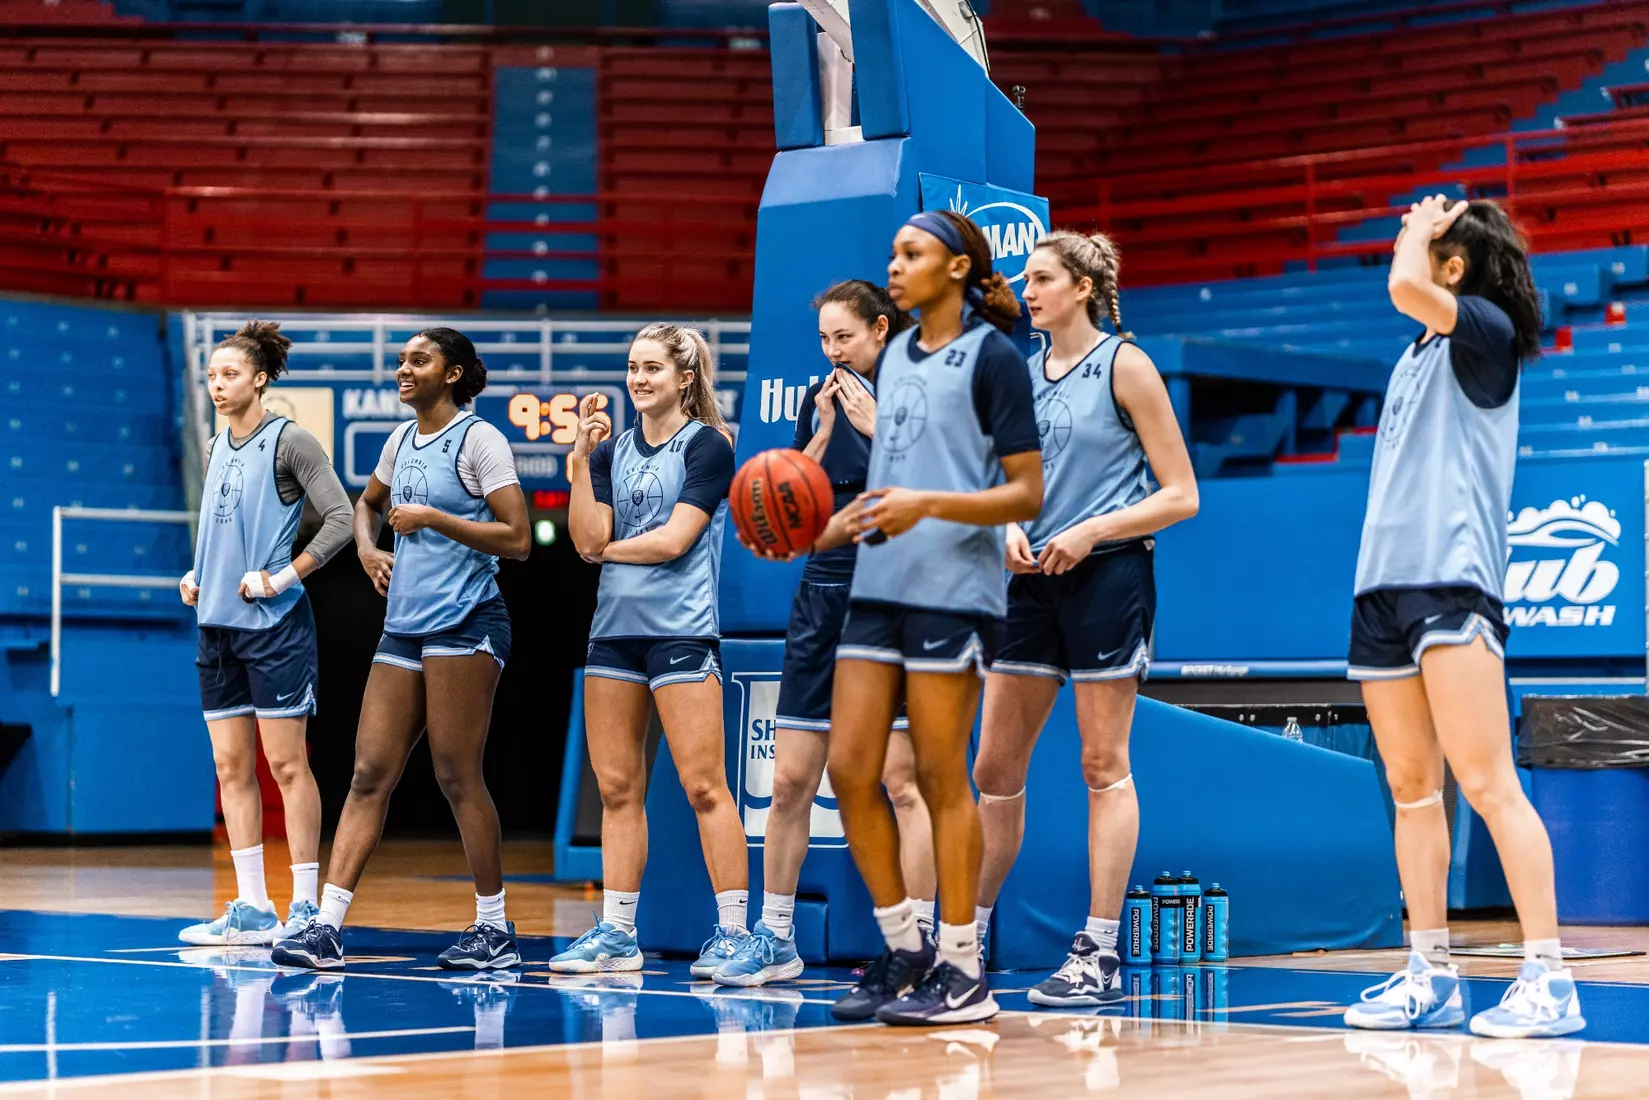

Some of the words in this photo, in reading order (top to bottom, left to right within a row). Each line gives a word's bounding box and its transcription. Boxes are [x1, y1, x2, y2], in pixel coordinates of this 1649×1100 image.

[944, 349, 966, 367] 23
[1082, 363, 1102, 379] 34
[760, 375, 819, 431] Hu
[257, 439, 266, 452] 4
[441, 439, 452, 453] 5
[1503, 542, 1619, 604] ub
[1503, 605, 1617, 627] WASH
[1132, 908, 1140, 955] POWERADE
[1186, 896, 1194, 951] POWERADE
